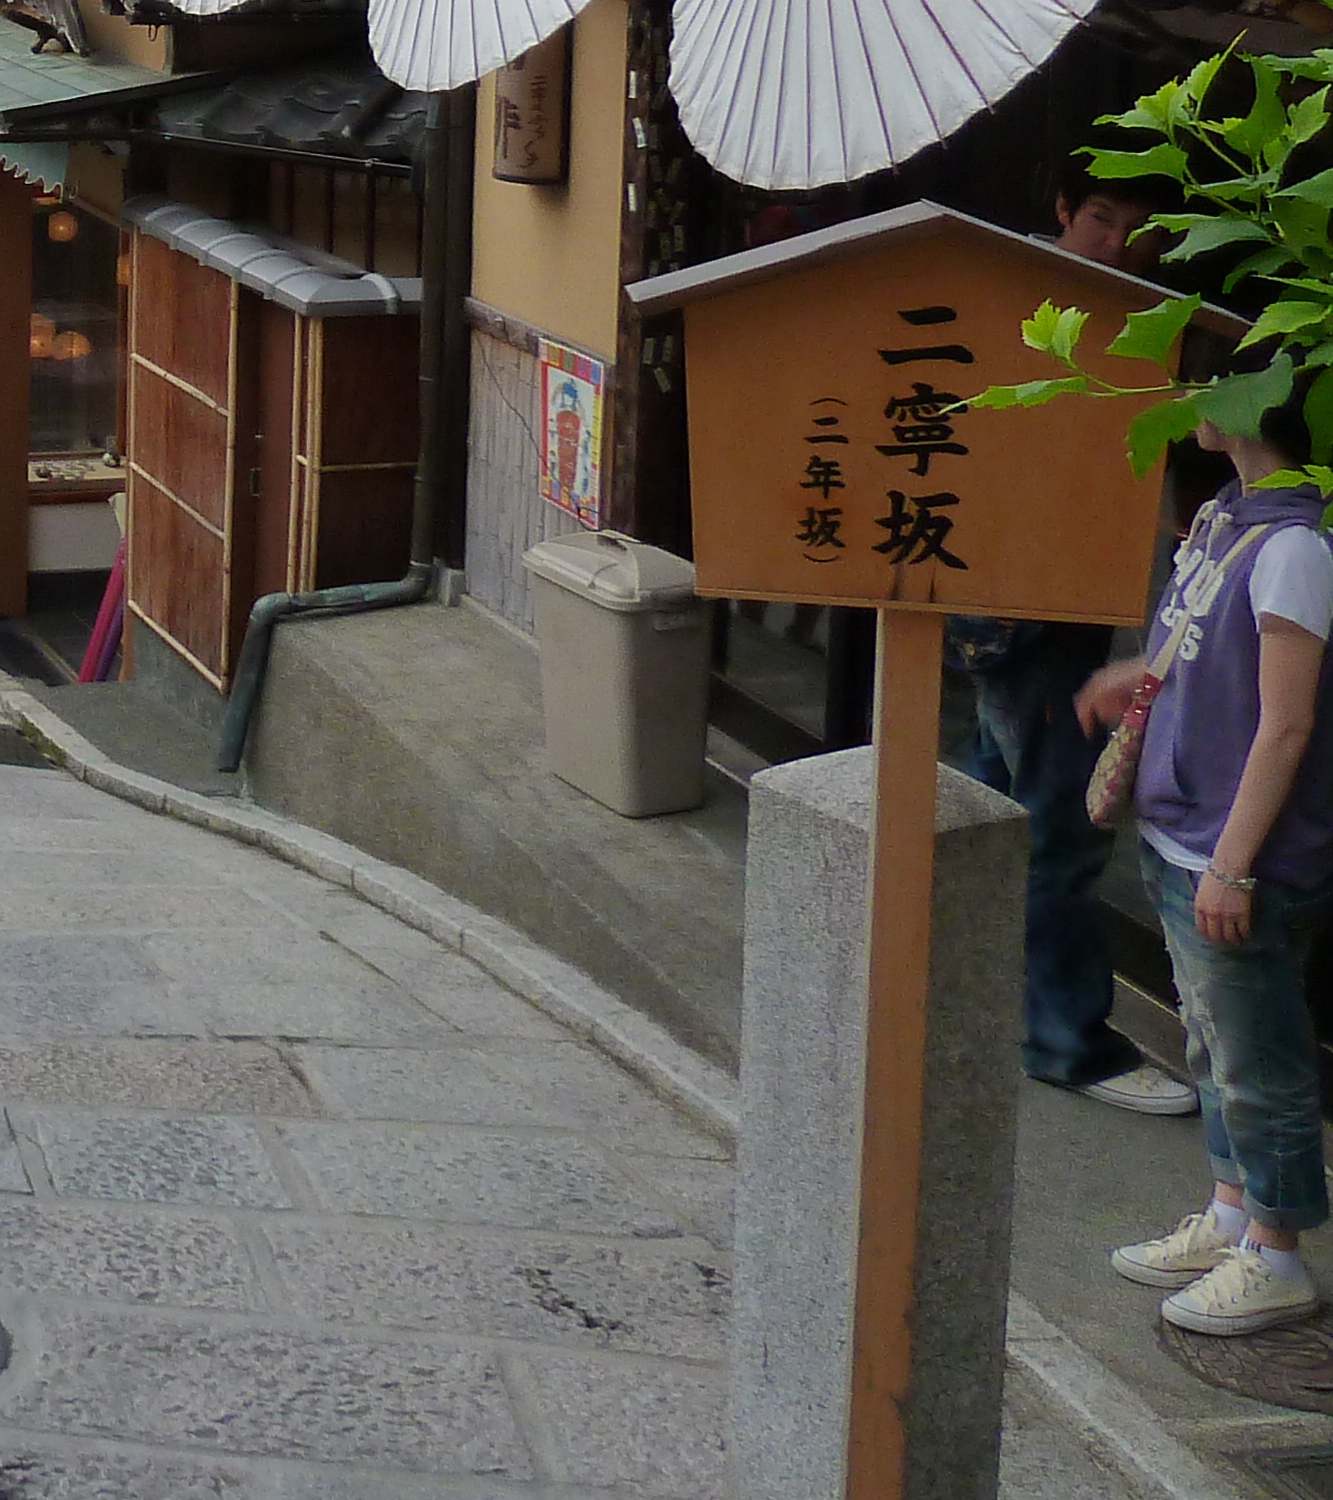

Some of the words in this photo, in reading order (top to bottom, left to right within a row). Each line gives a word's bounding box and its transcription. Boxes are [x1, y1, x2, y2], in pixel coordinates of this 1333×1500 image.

[795, 396, 851, 565] （二年坂）
[870, 305, 976, 570] 二寧坂
